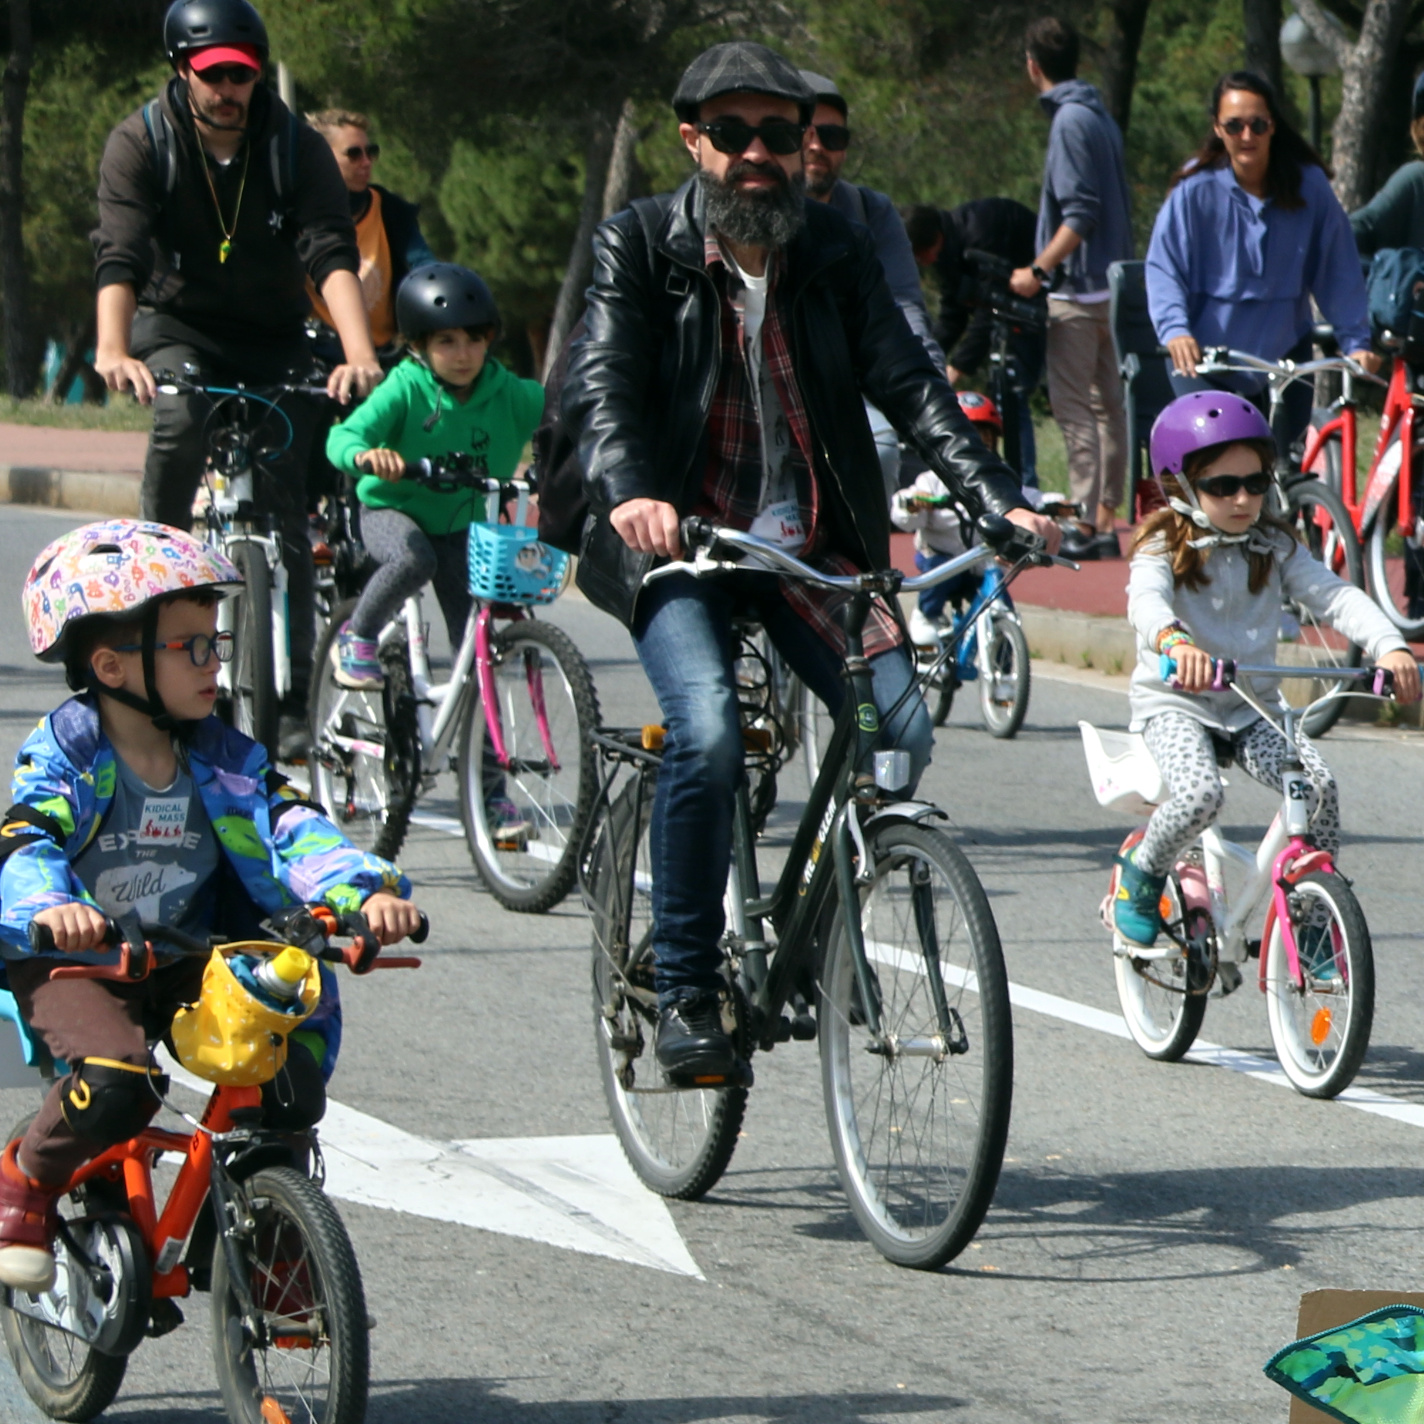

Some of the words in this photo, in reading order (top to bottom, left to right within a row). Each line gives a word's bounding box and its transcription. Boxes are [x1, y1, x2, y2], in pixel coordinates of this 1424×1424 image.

[144, 803, 183, 815] KIDICAL
[158, 813, 185, 823] MASS
[136, 849, 158, 858] THE
[111, 868, 167, 903] Wild
